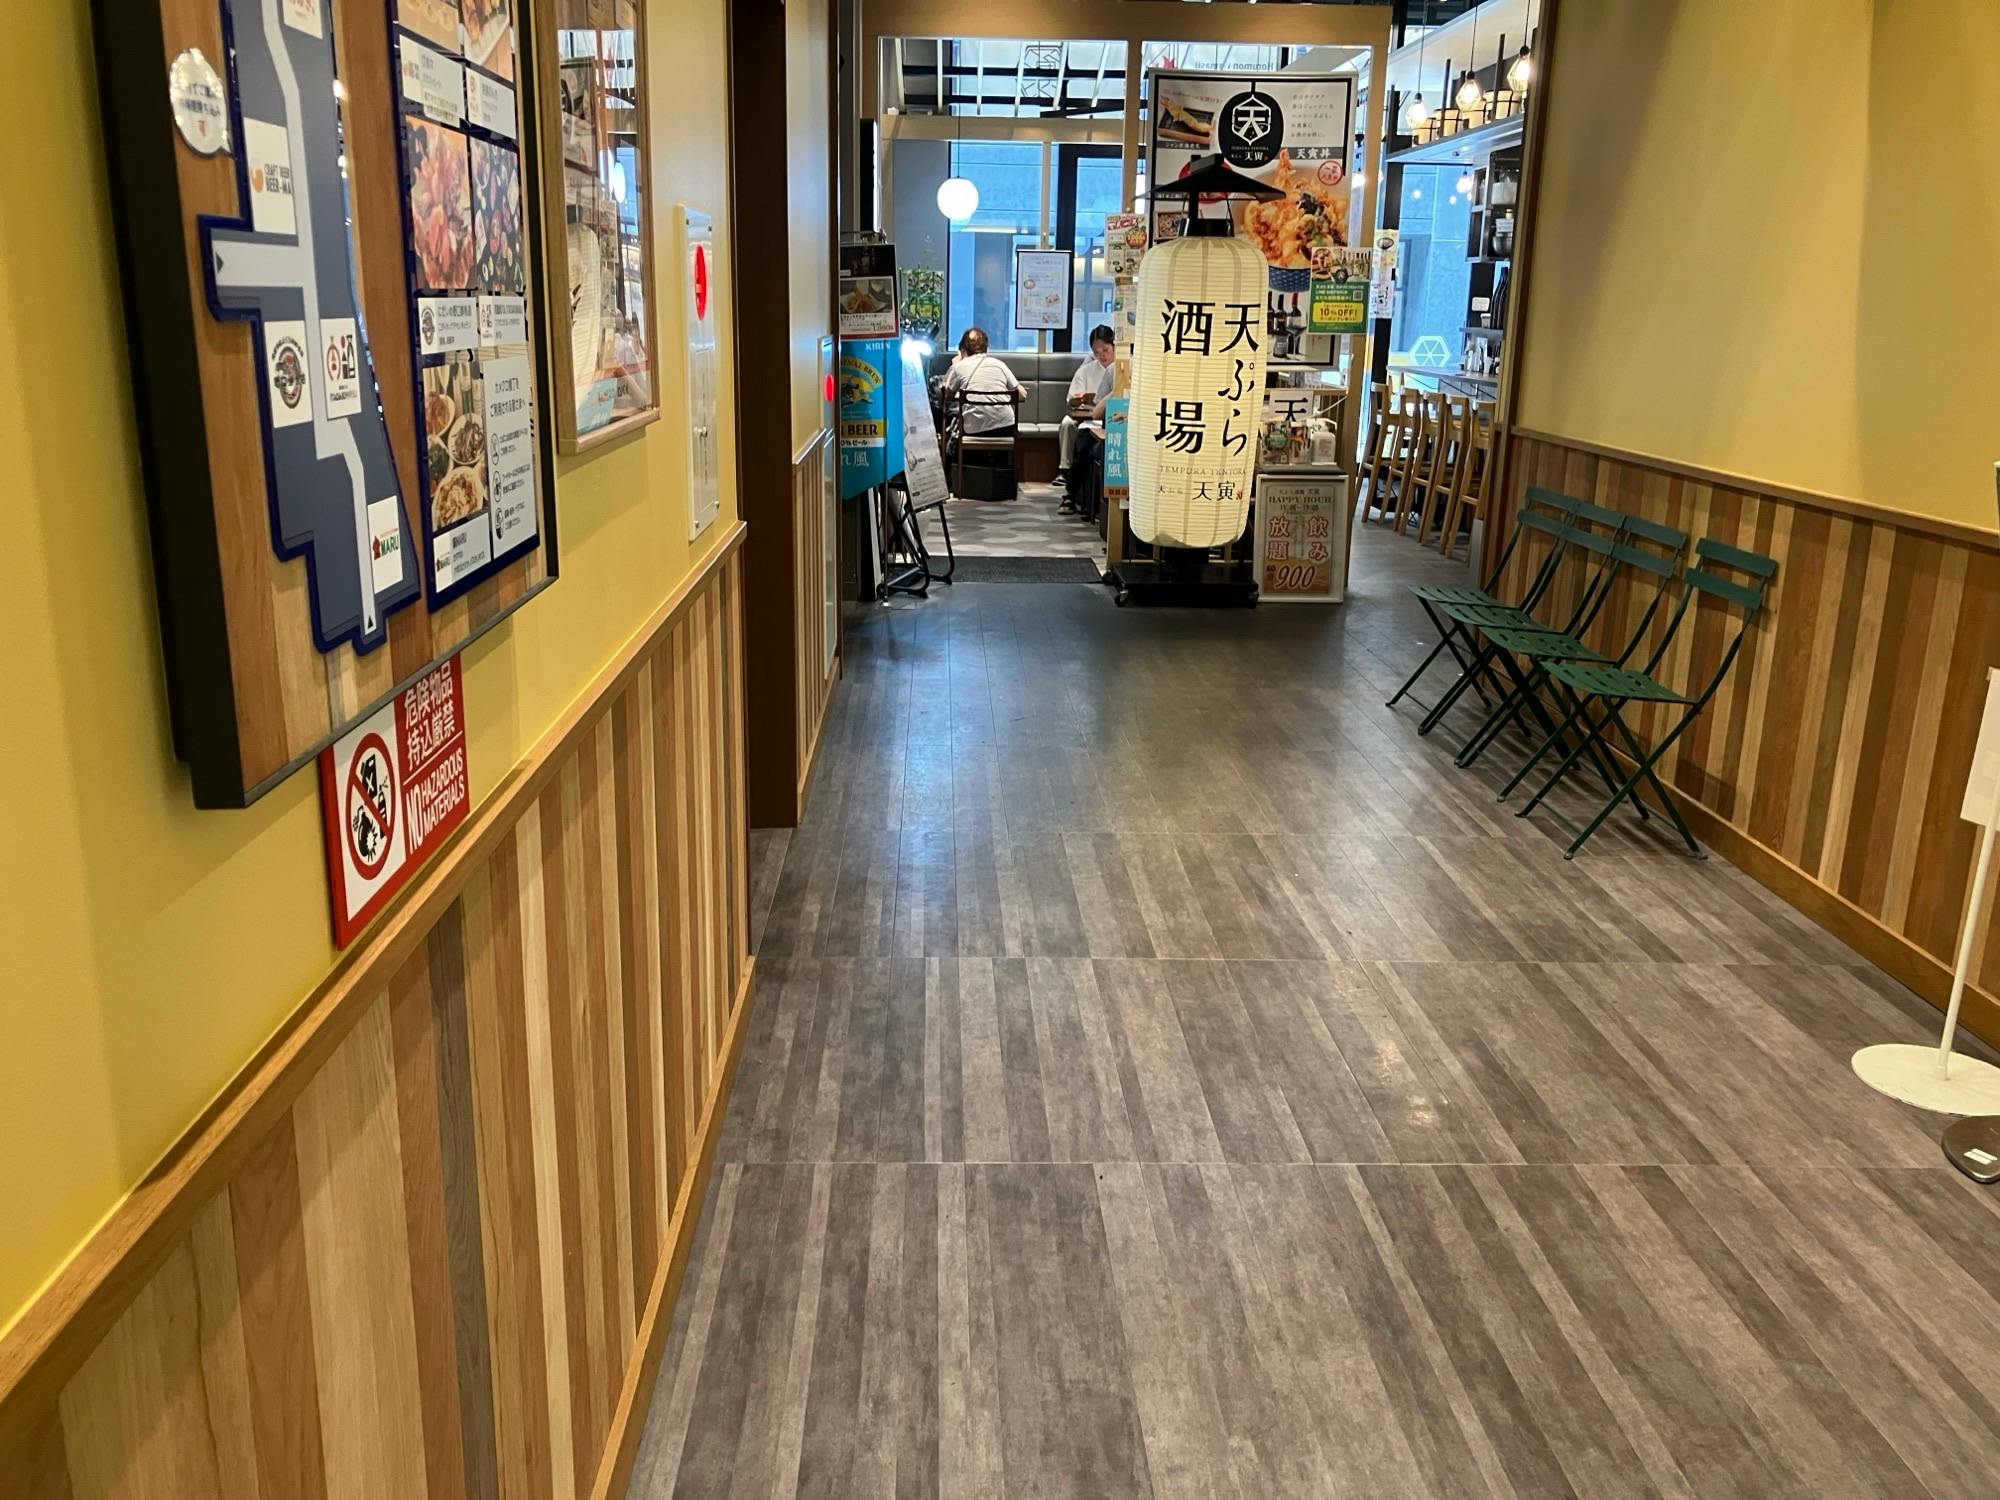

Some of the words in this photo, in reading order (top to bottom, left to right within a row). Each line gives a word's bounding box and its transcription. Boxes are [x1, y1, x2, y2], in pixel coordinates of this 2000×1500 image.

[865, 341, 891, 352] KIRIN
[1153, 298, 1216, 454] 酒場
[1217, 302, 1262, 457] 天ぷら
[847, 424, 878, 436] BEER
[1159, 465, 1206, 476] TEMPURA
[1192, 480, 1236, 501] 天寅
[1269, 496, 1300, 504] HAPPY
[1304, 496, 1331, 504] HOUR
[380, 535, 399, 556] MARU
[1268, 515, 1290, 561] 放題
[1308, 516, 1328, 561] 飲み
[1275, 564, 1316, 589] 900
[404, 660, 453, 731] 危険物品
[407, 704, 456, 771] 持込厳禁
[420, 747, 463, 804] HAZARDOUS
[406, 783, 424, 855] NO
[422, 775, 465, 838] MATERIALS
